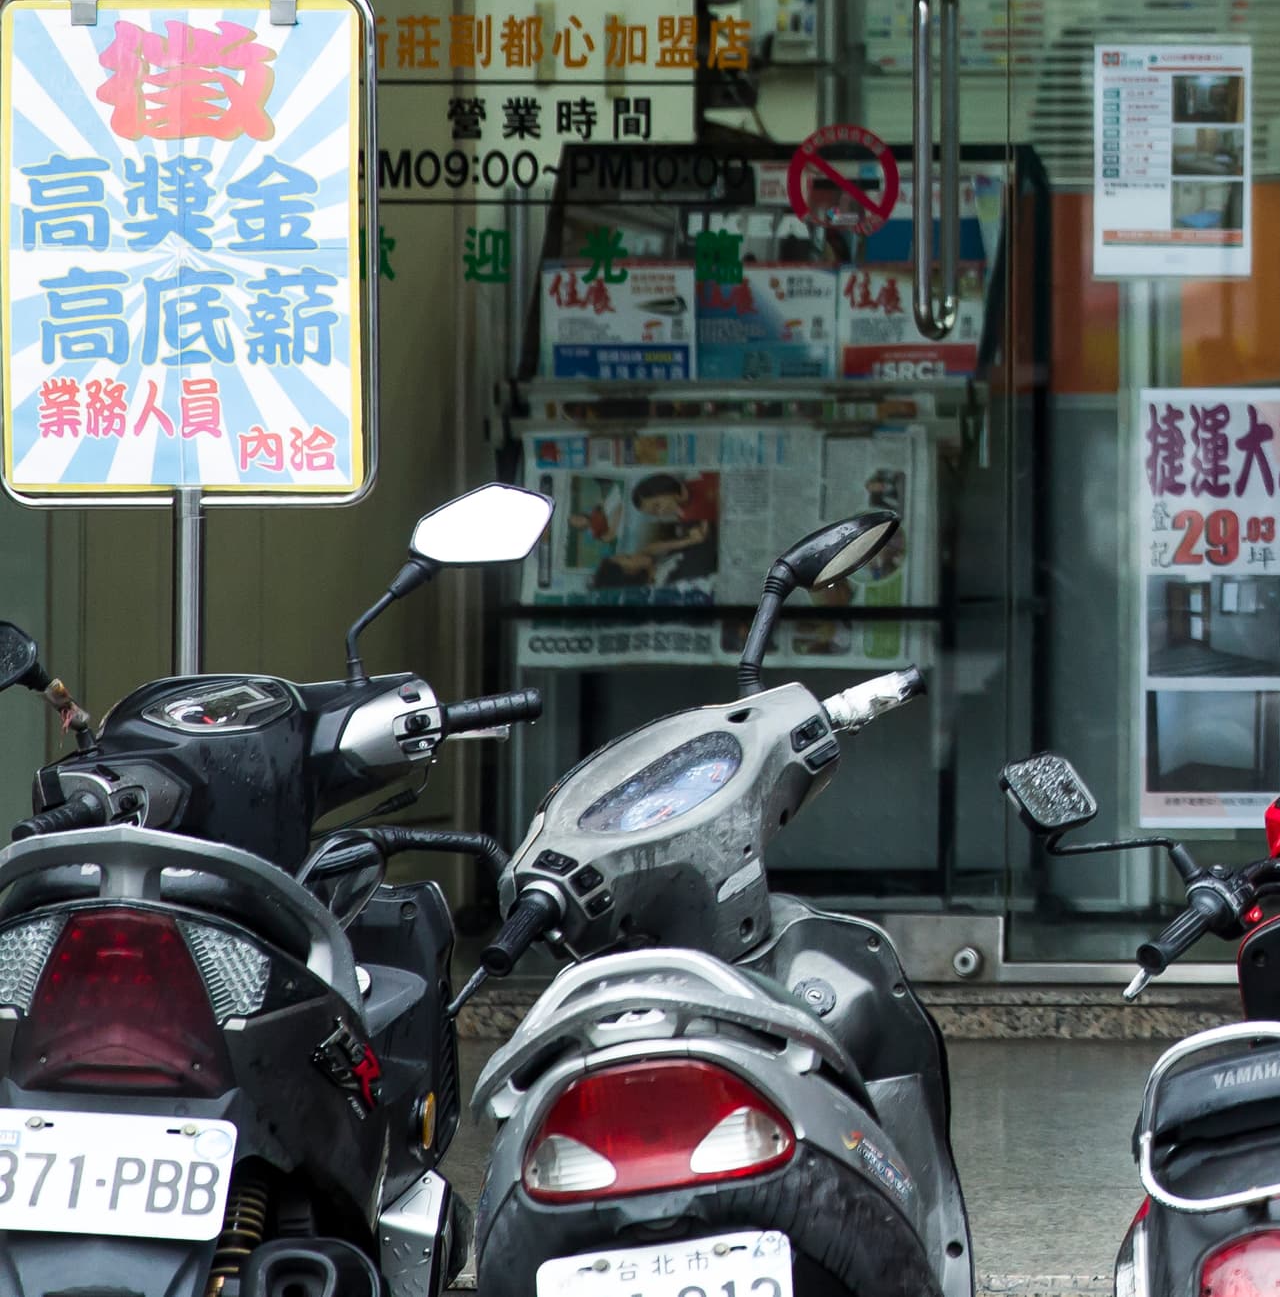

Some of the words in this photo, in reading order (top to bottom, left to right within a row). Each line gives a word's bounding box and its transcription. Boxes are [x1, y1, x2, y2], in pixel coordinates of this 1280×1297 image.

[97, 20, 275, 141] 徵
[447, 97, 652, 140] 營業時間
[20, 155, 321, 253] 高獎金
[40, 267, 339, 366] 高底薪
[40, 379, 222, 438] 業務人員
[240, 426, 338, 473] 內洽
[1150, 502, 1169, 566] 登記
[616, 1249, 711, 1282] 台北市
